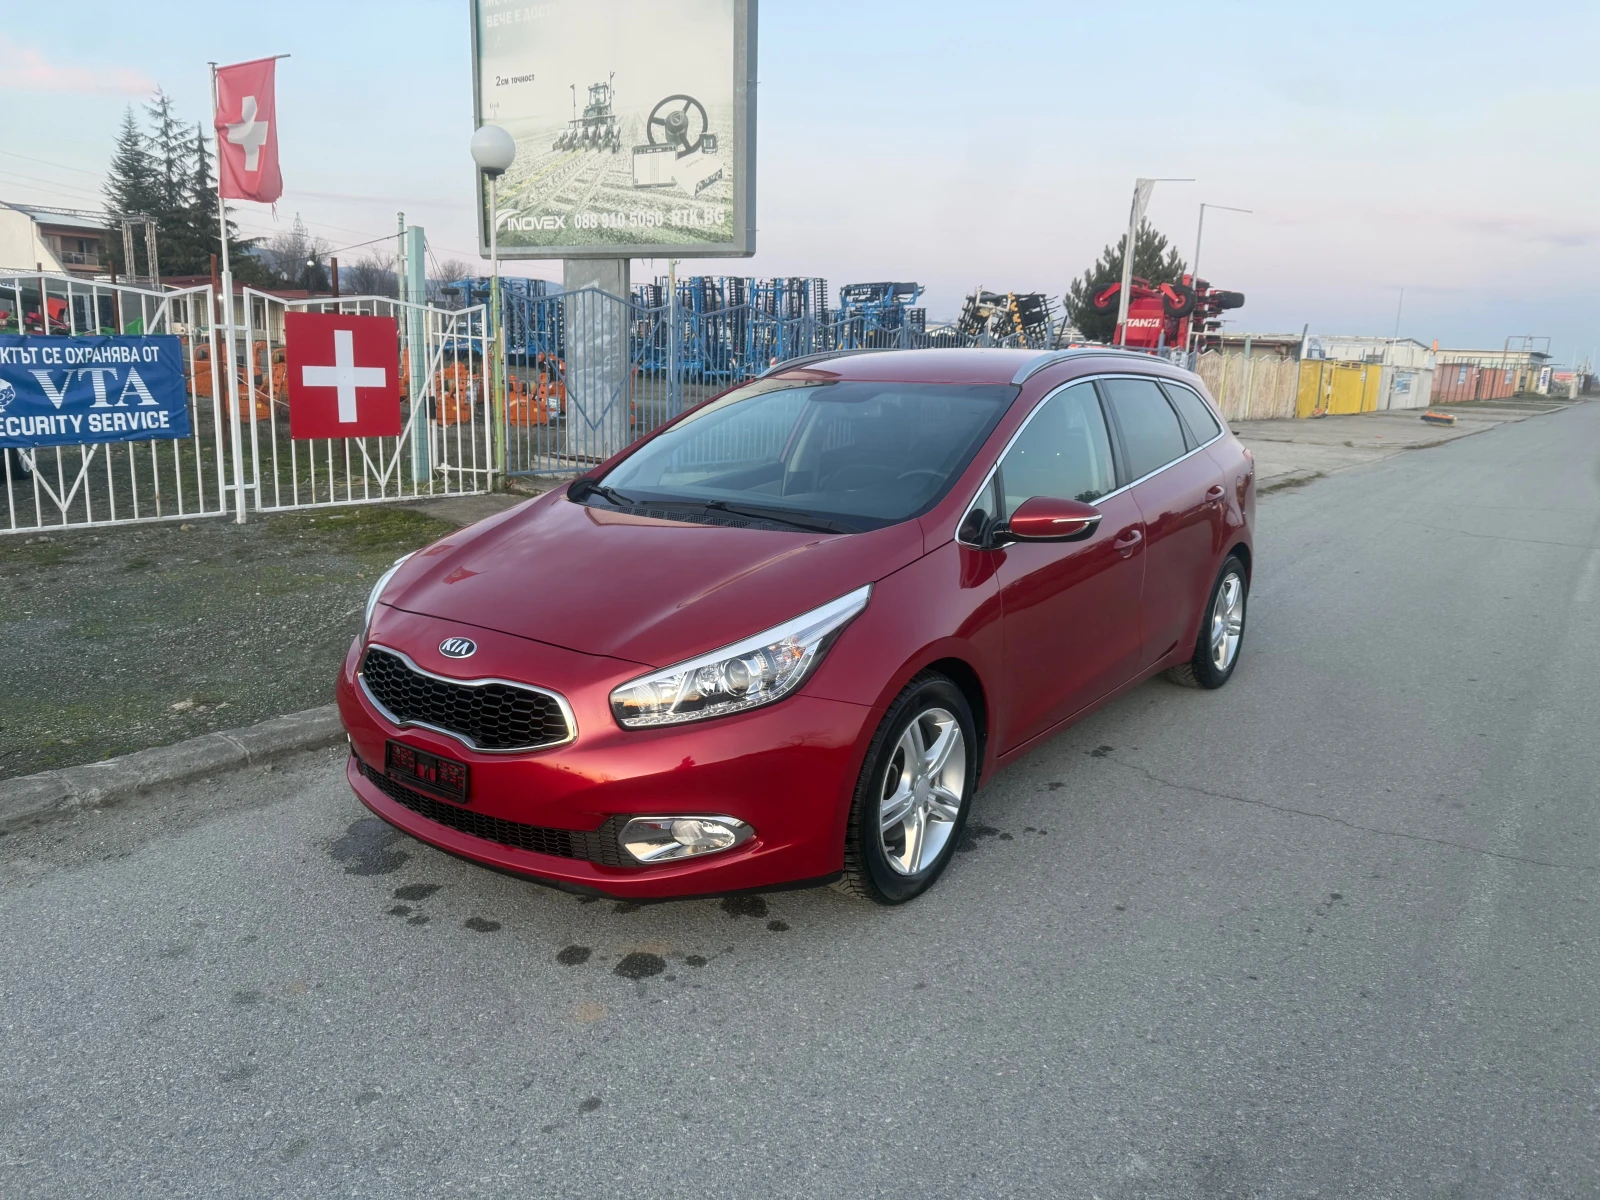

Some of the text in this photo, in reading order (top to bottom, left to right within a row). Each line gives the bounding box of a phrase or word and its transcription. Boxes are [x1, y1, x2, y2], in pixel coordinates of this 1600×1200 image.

[486, 11, 512, 29] ВЕЧЕ
[514, 8, 522, 22] Е
[523, 3, 557, 24] ДОСТ
[496, 73, 535, 87] 2см точност
[507, 215, 566, 231] INOVEX
[574, 212, 598, 229] 088
[601, 211, 626, 228] 910
[629, 208, 664, 227] 5050
[0, 346, 160, 364] КТЪТ СЕ ОХРАНЯВА ОТ
[28, 366, 160, 410] VTA
[88, 410, 170, 433] SERVICE
[441, 638, 470, 655] KIA
